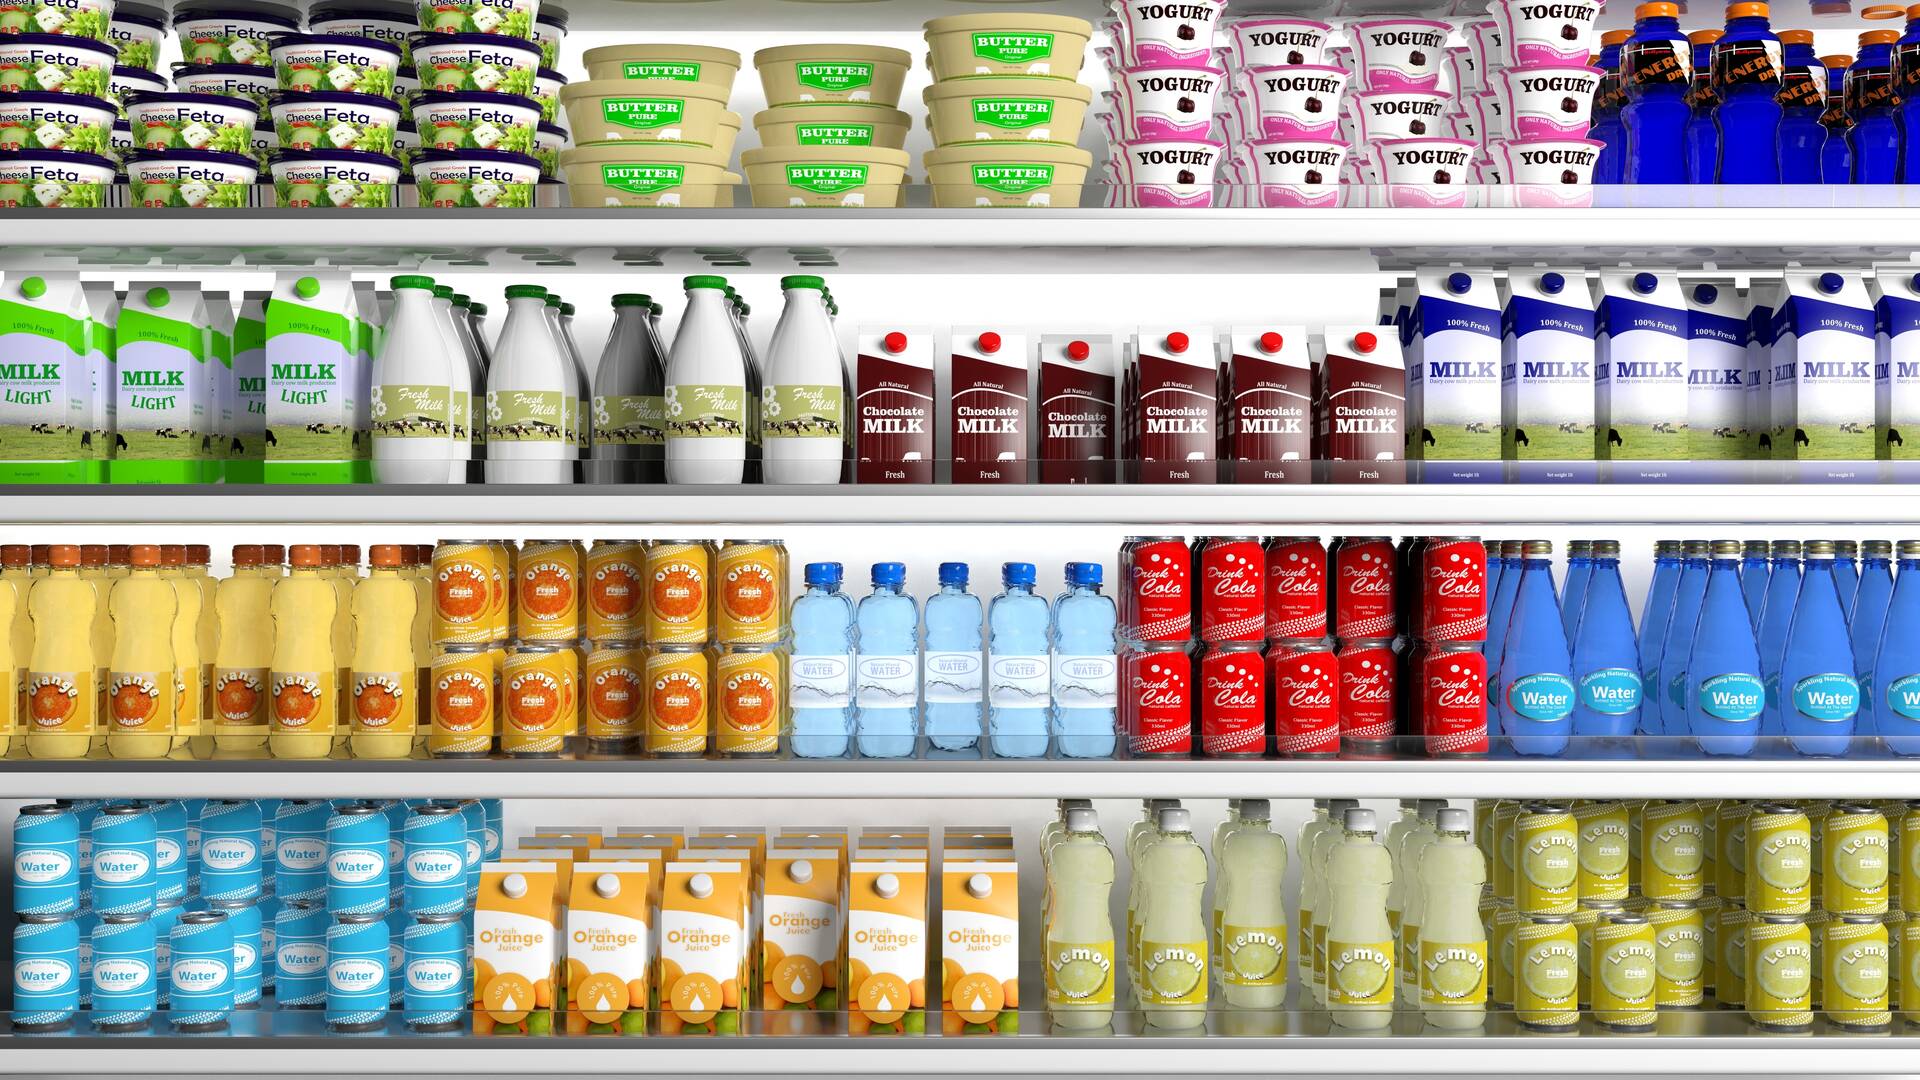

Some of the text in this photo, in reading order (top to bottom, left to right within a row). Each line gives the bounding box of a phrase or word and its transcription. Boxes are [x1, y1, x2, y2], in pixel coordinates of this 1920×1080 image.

[1137, 4, 1213, 22] YOGURT
[1520, 4, 1595, 22] YOGURT
[225, 25, 267, 40] Feta
[977, 37, 1048, 48] BUTTER
[1249, 32, 1320, 48] YOGURT
[1370, 32, 1442, 48] YOGURT
[30, 50, 78, 67] Feta
[286, 55, 321, 64] Cheese
[324, 50, 370, 66] Feta
[430, 55, 466, 64] Cheese
[469, 50, 514, 66] Feta
[627, 66, 695, 77] BUTTER
[802, 66, 868, 77] BUTTER
[1137, 78, 1213, 94] YOGURT
[1265, 78, 1340, 94] YOGURT
[1520, 78, 1595, 94] YOGURT
[606, 102, 679, 113] BUTTER
[977, 102, 1048, 113] BUTTER
[1370, 101, 1442, 117] YOGURT
[140, 108, 224, 125] Cheese Feta
[801, 128, 868, 138] BUTTER
[1393, 150, 1468, 167] YOGURT
[140, 166, 224, 182] Cheese Feta
[286, 166, 370, 182] Cheese Feta
[430, 166, 514, 182] Cheese Feta
[606, 168, 679, 180] BUTTER
[12, 322, 54, 335] 100% Fresh
[1469, 322, 1490, 332] Fresh
[1844, 322, 1864, 332] Fresh
[0, 364, 60, 380] MILK
[271, 364, 336, 380] MILK
[1430, 362, 1496, 378] MILK
[1523, 362, 1590, 378] MILK
[1803, 362, 1870, 378] MILK
[122, 371, 184, 386] MILK
[888, 381, 909, 389] Natural
[1172, 381, 1193, 389] Natural
[5, 389, 52, 404] LIGHT
[280, 389, 328, 404] LIGHT
[398, 388, 430, 399] Fresh
[514, 393, 544, 406] Fresh
[694, 388, 725, 400] Fresh
[131, 395, 176, 410] LIGHT
[416, 400, 443, 410] Milk
[711, 400, 738, 410] Milk
[530, 404, 556, 415] Milk
[863, 406, 924, 416] Chocolate
[958, 406, 1019, 416] Chocolate
[1146, 406, 1208, 416] Chocolate
[1336, 406, 1397, 416] Chocolate
[1048, 412, 1106, 421] Chocolate
[863, 419, 924, 433] MILK
[958, 419, 1019, 433] MILK
[1048, 424, 1106, 437] MILK
[1146, 419, 1208, 433] MILK
[1336, 419, 1397, 433] MILK
[886, 470, 905, 479] Fresh
[1170, 470, 1189, 479] Fresh
[1264, 470, 1284, 479] Fresh
[1133, 566, 1170, 578] Drink
[1208, 566, 1244, 578] Drink
[1430, 566, 1468, 578] Drink
[1140, 578, 1181, 596] Cola
[1214, 578, 1256, 596] Cola
[1278, 577, 1318, 594] Cola
[1439, 578, 1480, 596] Cola
[802, 666, 833, 675] WATER
[938, 662, 968, 670] WATER
[1073, 666, 1104, 675] WATER
[1208, 677, 1244, 689] Drink
[1214, 689, 1256, 706] Cola
[1522, 692, 1568, 705] Water
[1592, 686, 1636, 698] Water
[1712, 692, 1758, 705] Water
[1808, 692, 1853, 705] Water
[39, 718, 62, 726] Juice
[282, 718, 306, 726] Juice
[1529, 836, 1578, 855] Lemon
[209, 849, 246, 859] Water
[22, 862, 60, 872] Water
[336, 862, 374, 872] Water
[414, 862, 452, 872] Water
[1546, 859, 1568, 867] Fresh
[769, 914, 830, 928] Orange
[480, 931, 543, 946] Orange
[574, 931, 637, 946] Orange
[854, 931, 918, 945] Orange
[948, 931, 1012, 945] Orange
[1226, 931, 1284, 955] Lemon
[497, 944, 522, 952] Juice
[872, 944, 897, 952] Juice
[1050, 947, 1111, 973] Lemon
[1330, 948, 1392, 973] Lemon
[1424, 948, 1485, 973] Lemon
[1529, 946, 1578, 965] Lemon
[1607, 946, 1655, 965] Lemon
[22, 971, 60, 981] Water
[179, 971, 217, 981] Water
[1546, 969, 1568, 977] Fresh
[1625, 969, 1646, 977] Fresh
